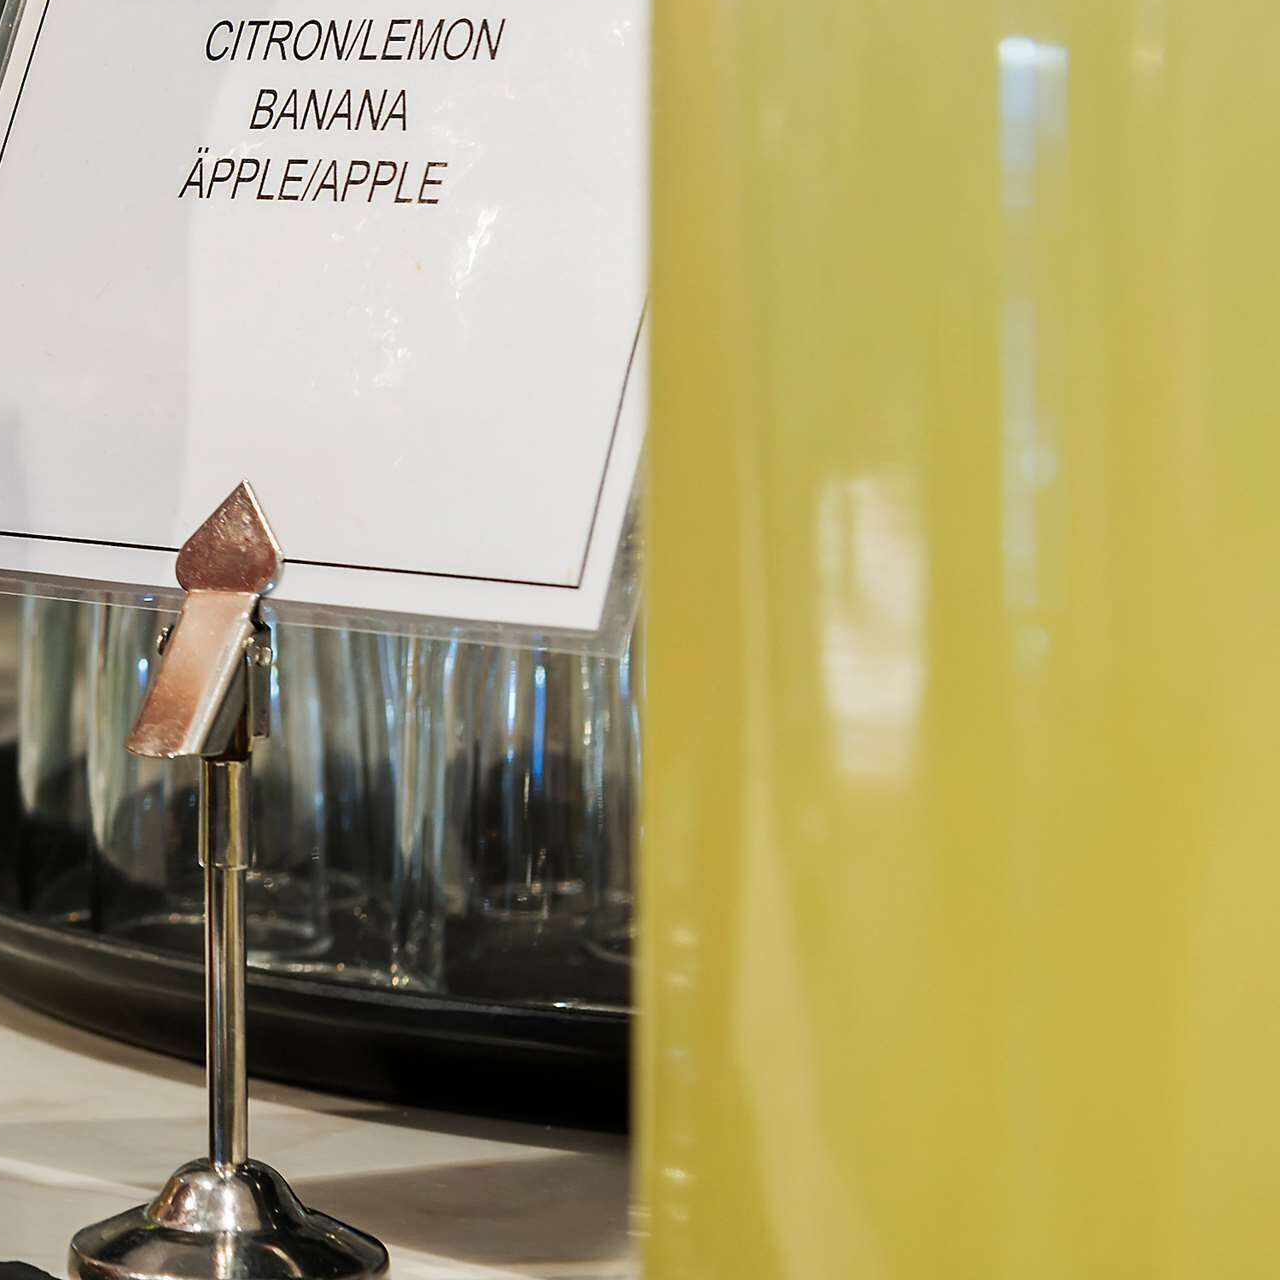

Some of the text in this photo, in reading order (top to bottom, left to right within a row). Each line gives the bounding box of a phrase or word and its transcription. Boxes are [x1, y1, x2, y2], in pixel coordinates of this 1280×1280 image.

[205, 18, 506, 62] CITRON/LEMON
[249, 88, 408, 132] BANANA
[178, 146, 449, 206] ÄPPLE/APPLE
